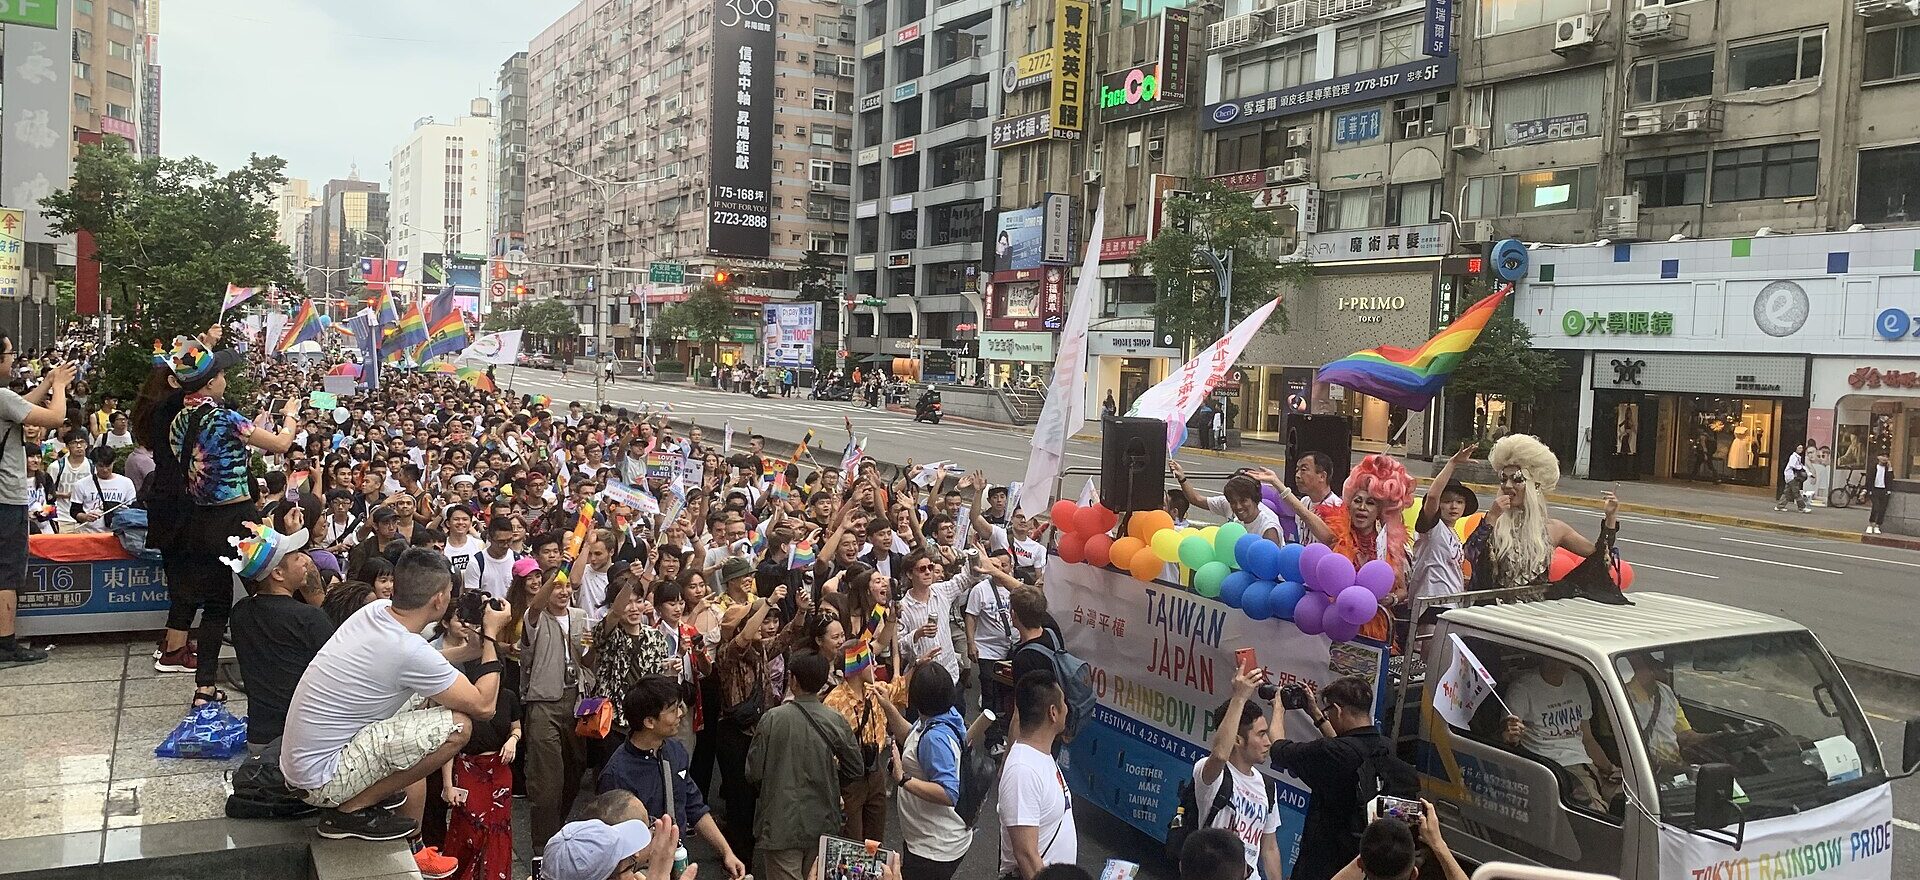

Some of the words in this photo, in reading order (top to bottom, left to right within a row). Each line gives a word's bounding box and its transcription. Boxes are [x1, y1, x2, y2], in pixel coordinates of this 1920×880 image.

[1433, 41, 1444, 51] 5F
[737, 45, 753, 106] 信義中軸
[1243, 97, 1277, 116] 雪瑞爾
[1354, 74, 1400, 93] 2778-1517
[1423, 64, 1440, 81] 5F
[721, 201, 738, 210] NOT
[738, 203, 753, 212] FOR
[752, 205, 768, 213] YOU
[713, 211, 768, 229] 2723-2888
[1350, 232, 1421, 253] 魔術真髮
[1358, 315, 1382, 324] TOKYO
[1586, 311, 1674, 335] 大學眼鏡
[90, 491, 123, 502] TAWAN
[32, 566, 74, 592] 16
[108, 591, 136, 603] East
[1073, 604, 1126, 639] 台灣平權
[1145, 588, 1227, 649] TAIWAN
[1146, 636, 1214, 696] JAPAN
[1114, 674, 1197, 736] RAINBOW
[1099, 712, 1138, 739] FESTIVAL
[1138, 728, 1159, 745] 4.25
[1160, 737, 1179, 752] SAT
[1138, 780, 1162, 794] MAKE
[1128, 792, 1160, 809] TAIWAN
[1279, 788, 1306, 809] AND
[1132, 808, 1158, 824] BETTER
[1759, 837, 1842, 880] RAINBOW
[1851, 819, 1892, 862] PRIDE
